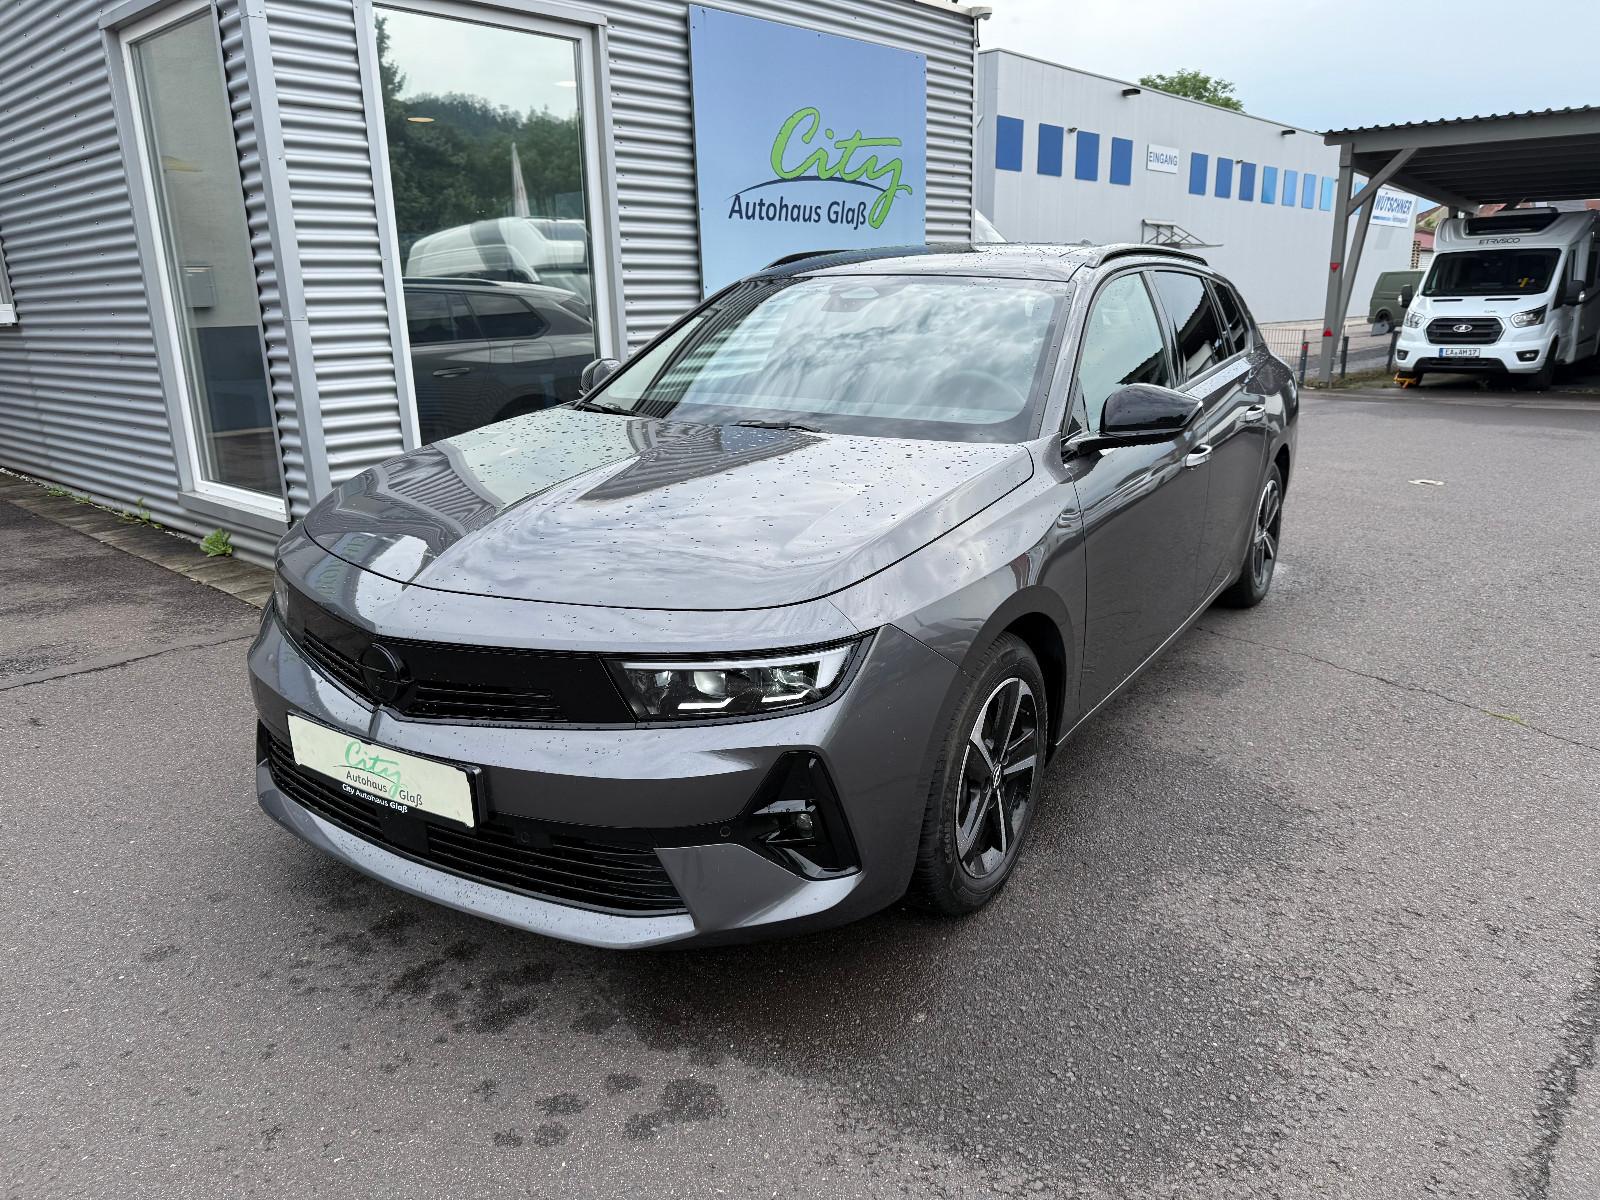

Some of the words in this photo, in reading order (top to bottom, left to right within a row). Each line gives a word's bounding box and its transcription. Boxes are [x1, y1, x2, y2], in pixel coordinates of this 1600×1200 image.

[770, 107, 912, 229] City
[1149, 152, 1178, 166] EINGANG
[728, 194, 821, 223] Autohaus
[827, 200, 867, 230] Glaß
[345, 741, 405, 799] City
[342, 783, 355, 794] City
[355, 789, 389, 807] Autohaus
[389, 801, 408, 813] Glaß
[346, 770, 388, 793] Autohaus
[399, 790, 423, 808] Glaß
